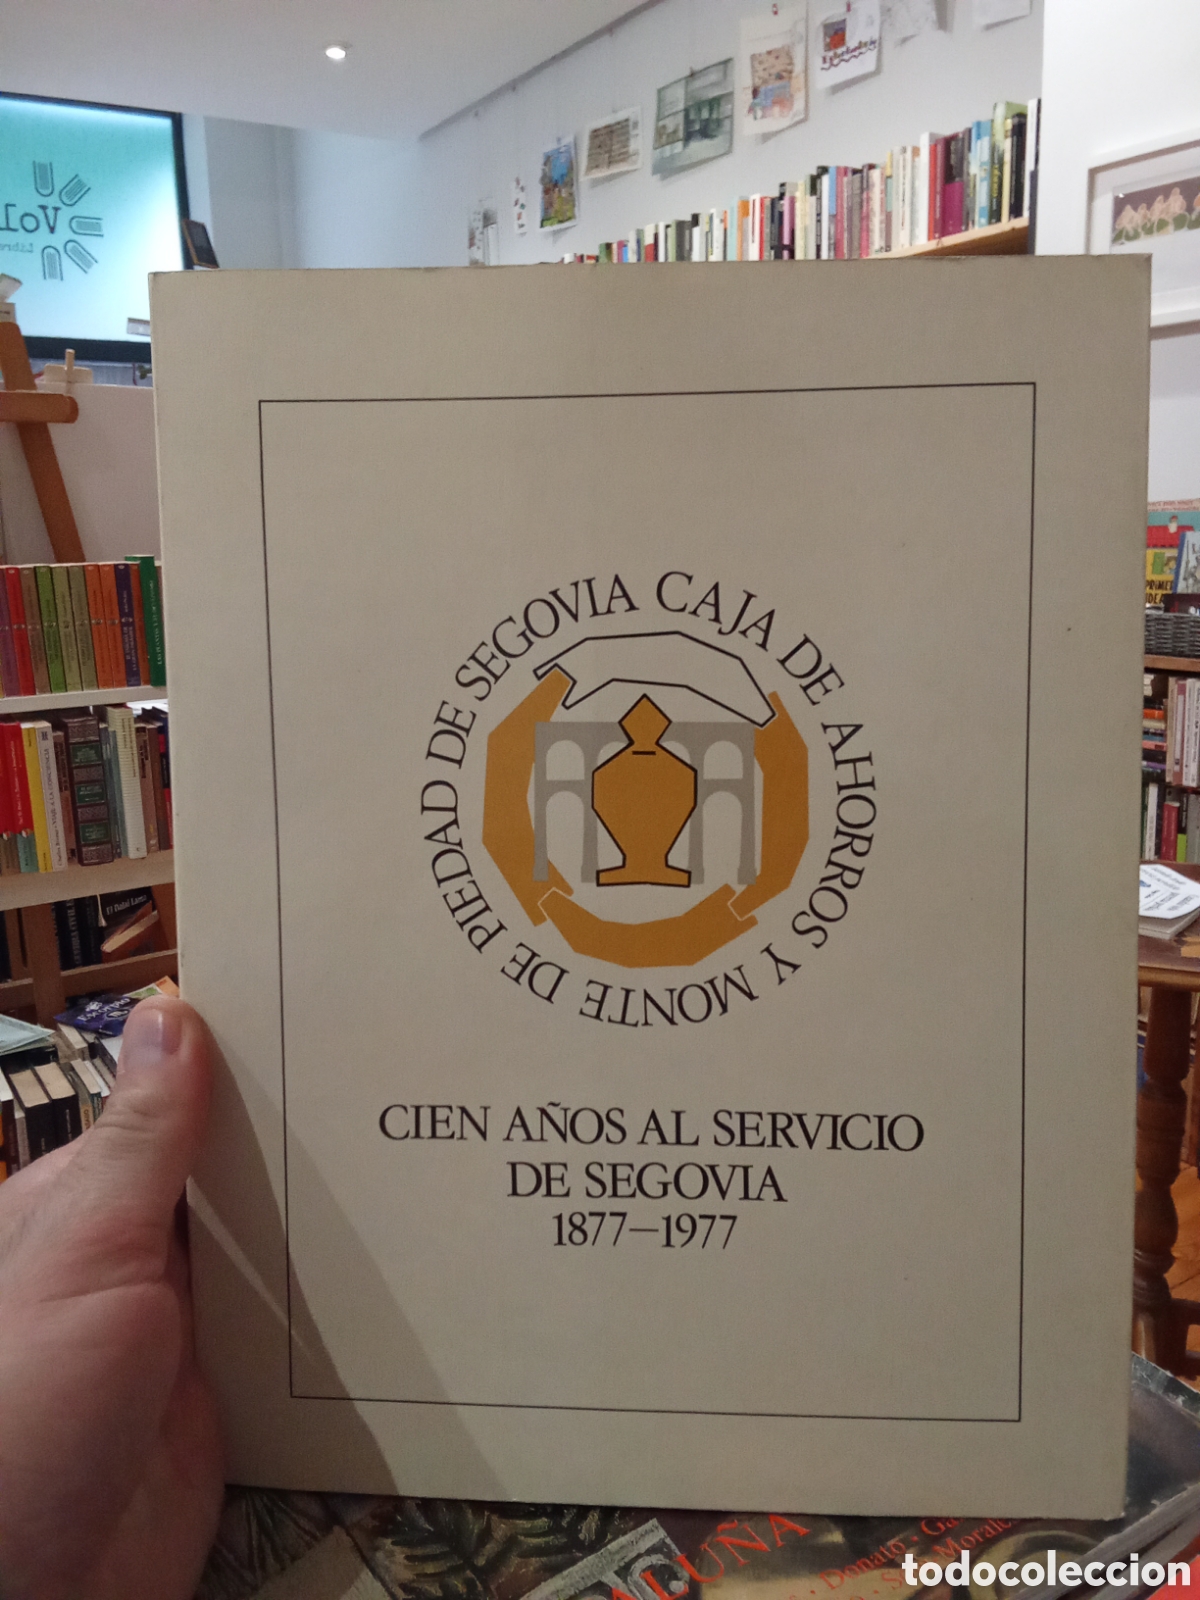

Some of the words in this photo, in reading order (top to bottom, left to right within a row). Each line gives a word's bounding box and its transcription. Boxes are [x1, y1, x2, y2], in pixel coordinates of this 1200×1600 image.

[455, 573, 640, 702] SEGOVIA
[656, 571, 775, 652] CAJA
[776, 633, 845, 706] DE
[425, 700, 477, 770] DE
[420, 780, 508, 955] PIEDAD
[792, 721, 877, 949] AHORROS
[500, 942, 570, 1005] DE
[579, 964, 760, 1027] MONTE
[760, 942, 802, 985] Y
[379, 1104, 491, 1141] CIEN
[502, 1101, 627, 1144] AÑOS
[637, 1108, 700, 1146] AL
[713, 1109, 925, 1151] SERVICIO
[506, 1161, 571, 1197] DE
[585, 1162, 788, 1202] SEGOVIA
[819, 1541, 907, 1590] Donato
